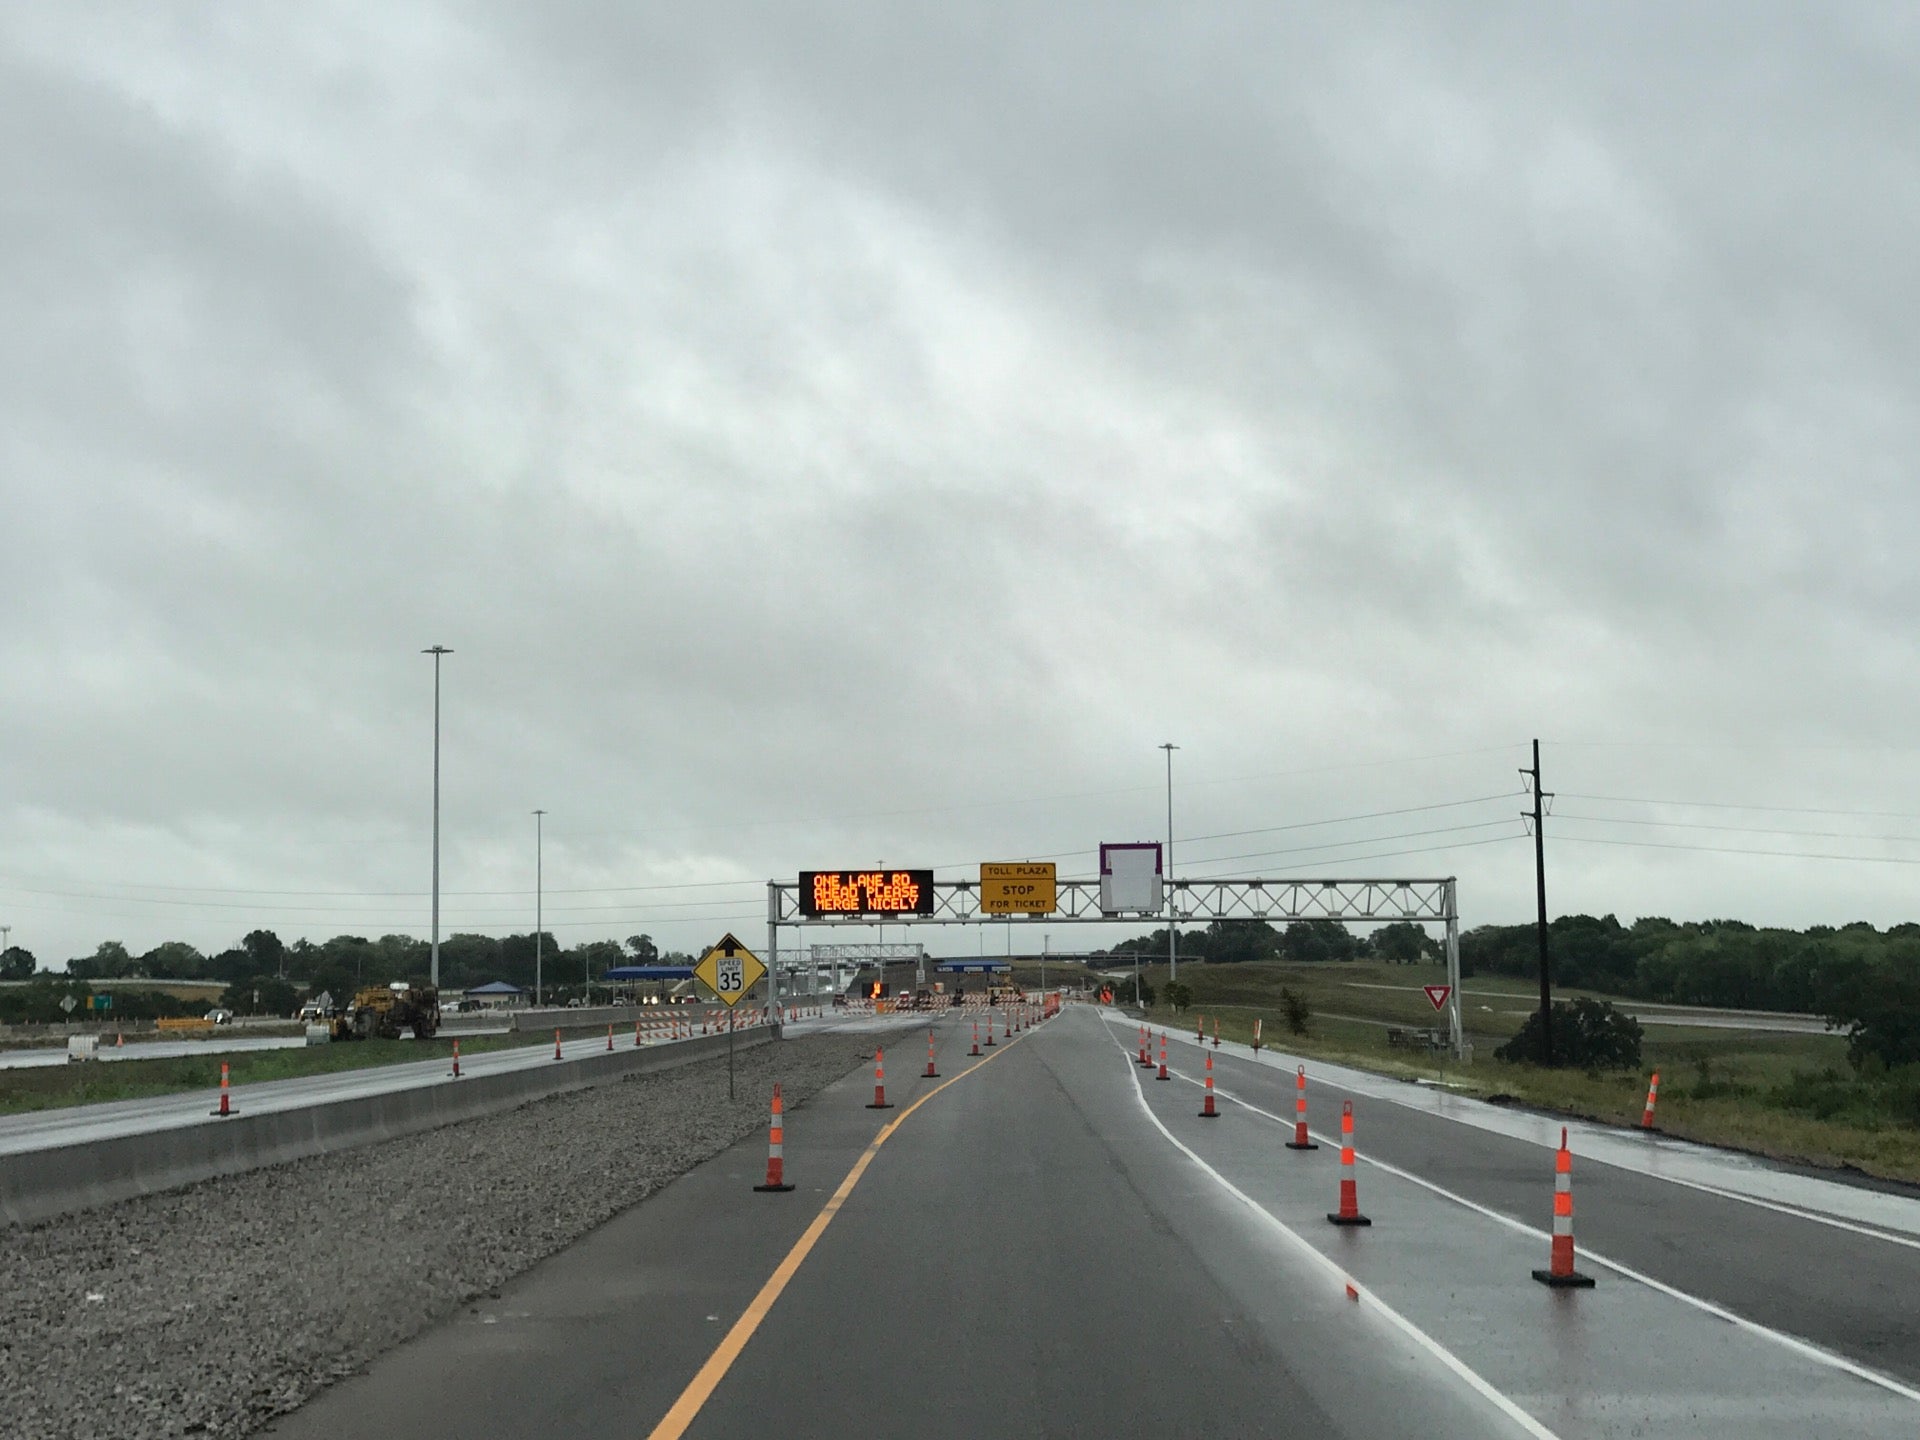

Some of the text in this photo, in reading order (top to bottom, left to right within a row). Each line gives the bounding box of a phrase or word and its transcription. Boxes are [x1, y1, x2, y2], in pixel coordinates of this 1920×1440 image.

[988, 867, 1048, 875] TOLL PLAZA
[814, 873, 910, 887] ONE LANE RD
[814, 885, 919, 899] AHEAD PLEASE
[1002, 885, 1034, 895] STOP
[815, 897, 917, 910] MERGE NICELY
[990, 900, 1046, 908] FOR TICKET
[720, 972, 742, 991] 35
